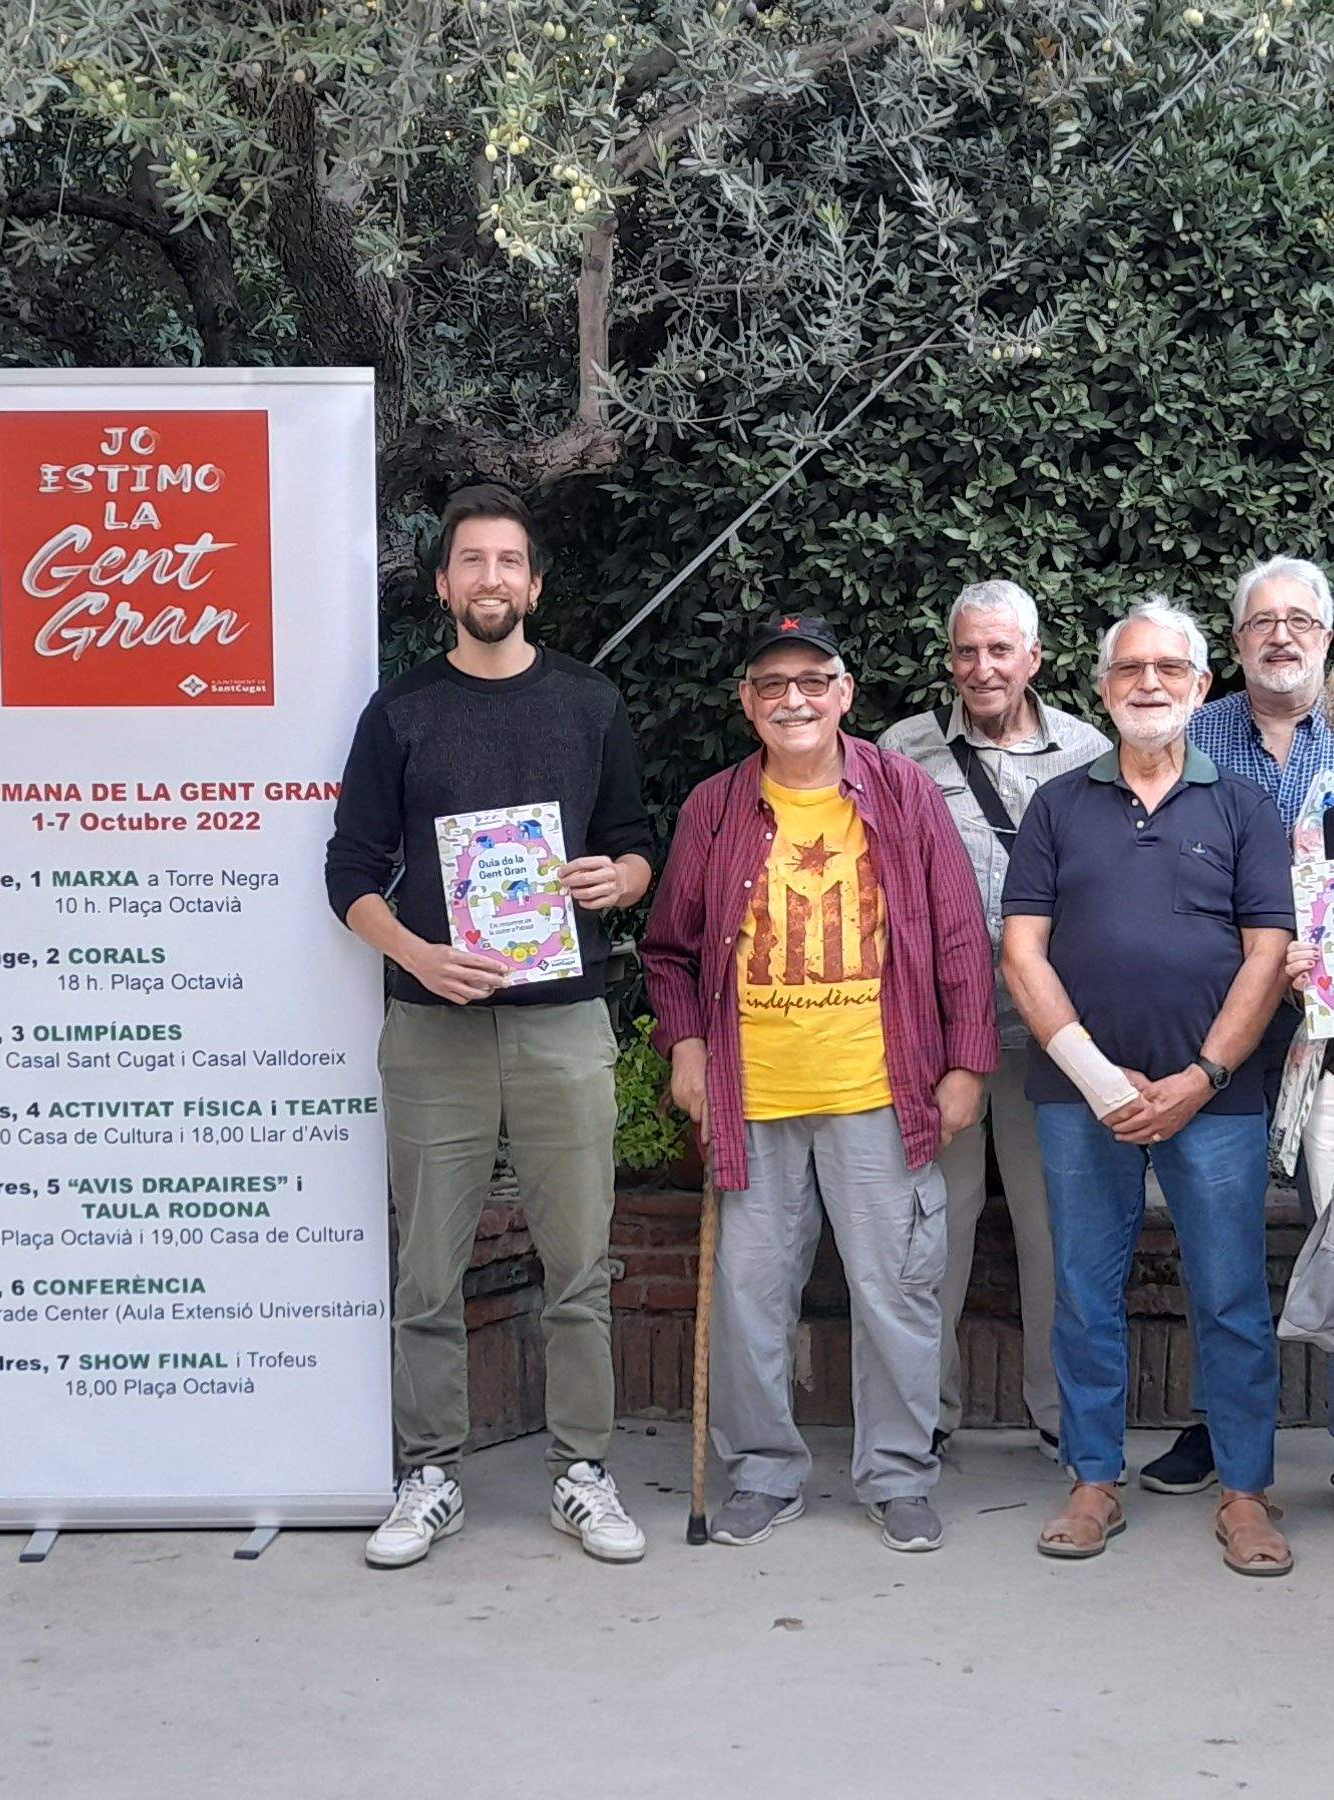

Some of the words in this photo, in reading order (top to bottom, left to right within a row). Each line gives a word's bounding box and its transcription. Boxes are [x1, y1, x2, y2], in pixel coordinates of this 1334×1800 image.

[100, 426, 160, 456] JO
[39, 463, 226, 494] ESTIMO
[104, 501, 162, 530] LA
[21, 524, 238, 599] Gent
[33, 591, 250, 662] Gran
[91, 782, 128, 802] DE
[136, 782, 172, 802] LA
[179, 782, 255, 802] GENT
[264, 781, 342, 801] GRAN
[31, 812, 71, 832] 1-7
[79, 812, 188, 832] Octubre
[196, 811, 261, 831] 2022
[30, 870, 41, 888] 1
[52, 870, 140, 888] MARXA
[147, 873, 160, 887] a
[164, 869, 214, 887] Torre
[221, 869, 279, 891] Negra
[55, 896, 78, 914] 10
[84, 896, 101, 914] h.
[109, 896, 162, 918] Plaça
[169, 895, 242, 914] Octavià
[46, 947, 60, 965] 2
[68, 947, 166, 965] CORALS
[58, 973, 80, 991] 18
[86, 974, 104, 991] h.
[111, 973, 165, 995] Plaça
[170, 972, 244, 991] Octavià
[11, 1025, 25, 1042] 3
[32, 1020, 183, 1042] OLIMPÍADES
[5, 1051, 60, 1069] Casal
[66, 1051, 111, 1069] Sant
[116, 1050, 176, 1072] Cugat
[181, 1050, 186, 1067] i
[192, 1049, 247, 1068] Casal
[252, 1048, 346, 1067] Valldoreix
[25, 1101, 41, 1119] 4
[48, 1100, 175, 1119] ACTIVITAT
[183, 1096, 263, 1118] FÍSICA
[271, 1099, 277, 1117] i
[284, 1096, 379, 1116] TEATRE
[17, 1127, 68, 1146] Casa
[73, 1127, 98, 1145] de
[104, 1127, 173, 1145] Cultura
[179, 1126, 184, 1144] i
[191, 1125, 244, 1146] 18,00
[250, 1125, 287, 1143] Llar
[47, 1178, 61, 1195] 5
[296, 1175, 303, 1192] i
[80, 1202, 160, 1220] TAULA
[168, 1201, 271, 1219] RODONA
[1, 1229, 54, 1251] Plaça
[60, 1228, 133, 1246] Octavià
[139, 1228, 144, 1246] i
[151, 1227, 204, 1248] 19,00
[210, 1227, 259, 1245] Casa
[265, 1226, 289, 1244] de
[295, 1225, 364, 1244] Cultura
[11, 1279, 25, 1297] 6
[32, 1274, 206, 1296] CONFERÈNCIA
[44, 1304, 110, 1322] Center
[115, 1303, 165, 1325] (Aula
[171, 1302, 254, 1321] Extensió
[259, 1298, 386, 1320] Universitària)
[56, 1354, 70, 1371] 7
[79, 1353, 151, 1371] SHOW
[158, 1352, 229, 1370] FINAL
[236, 1351, 241, 1369] i
[246, 1350, 317, 1368] Trofeus
[65, 1379, 118, 1399] 18,00
[123, 1378, 177, 1399] Plaça
[183, 1376, 255, 1395] Octavià
